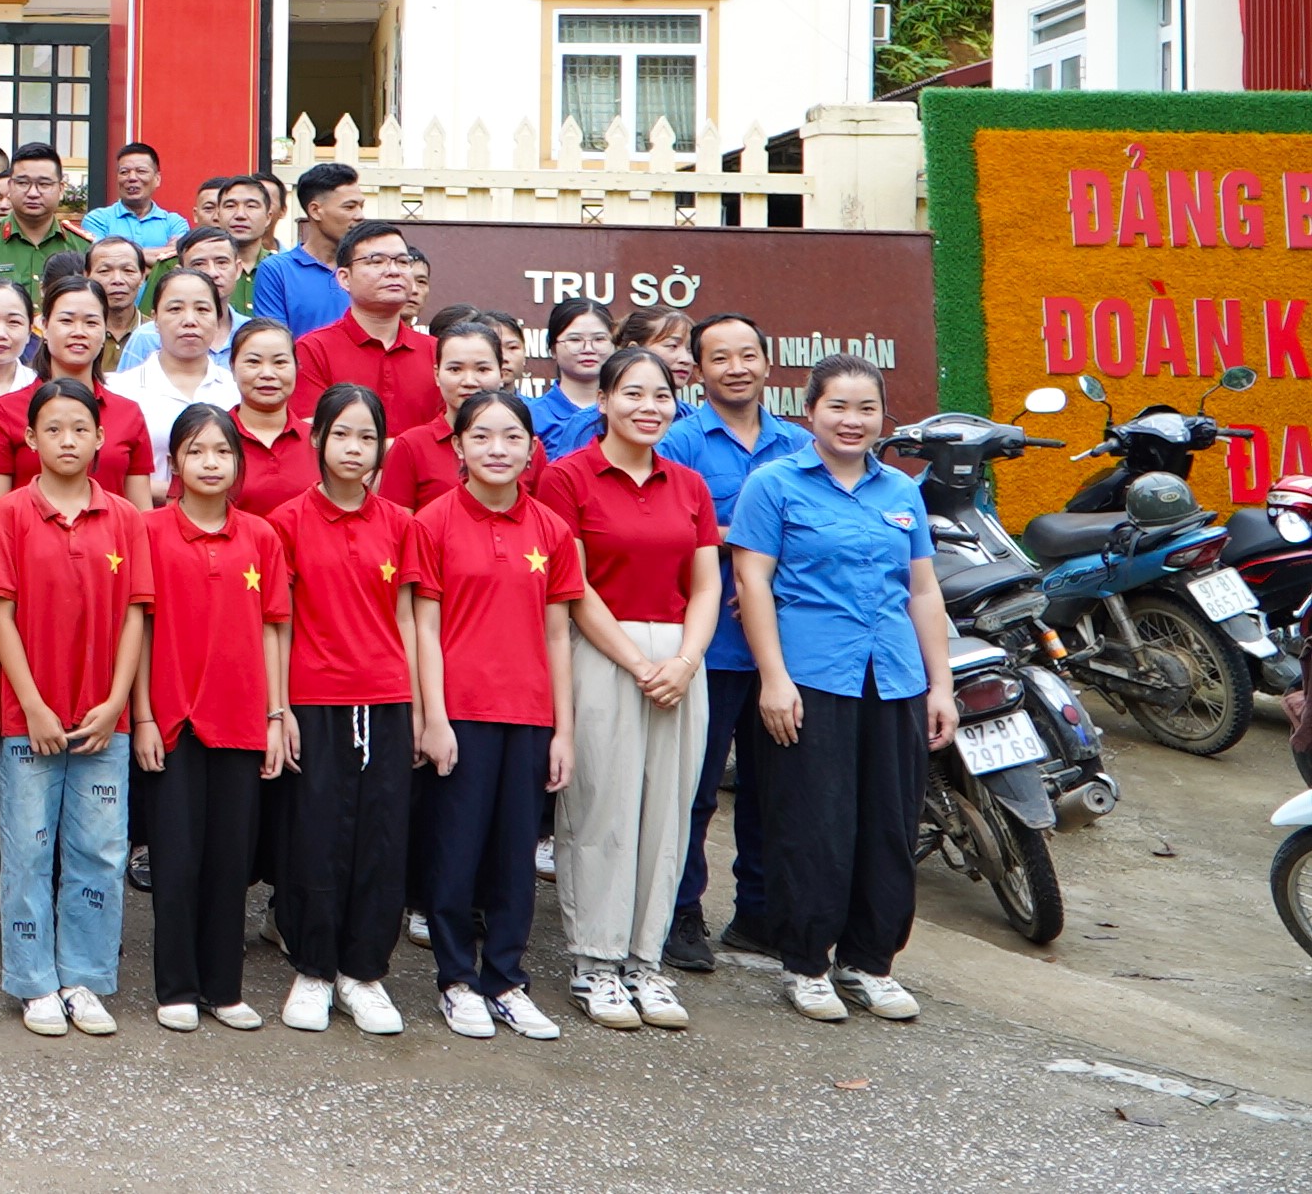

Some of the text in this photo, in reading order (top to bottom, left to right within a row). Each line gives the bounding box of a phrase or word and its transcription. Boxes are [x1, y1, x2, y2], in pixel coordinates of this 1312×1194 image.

[1067, 143, 1265, 248] ĐẢNG
[630, 263, 700, 307] SỞ
[1041, 280, 1247, 377] ĐOÀN
[779, 332, 840, 367] NHÂN
[11, 745, 33, 756] min
[967, 737, 1038, 770] 297.69
